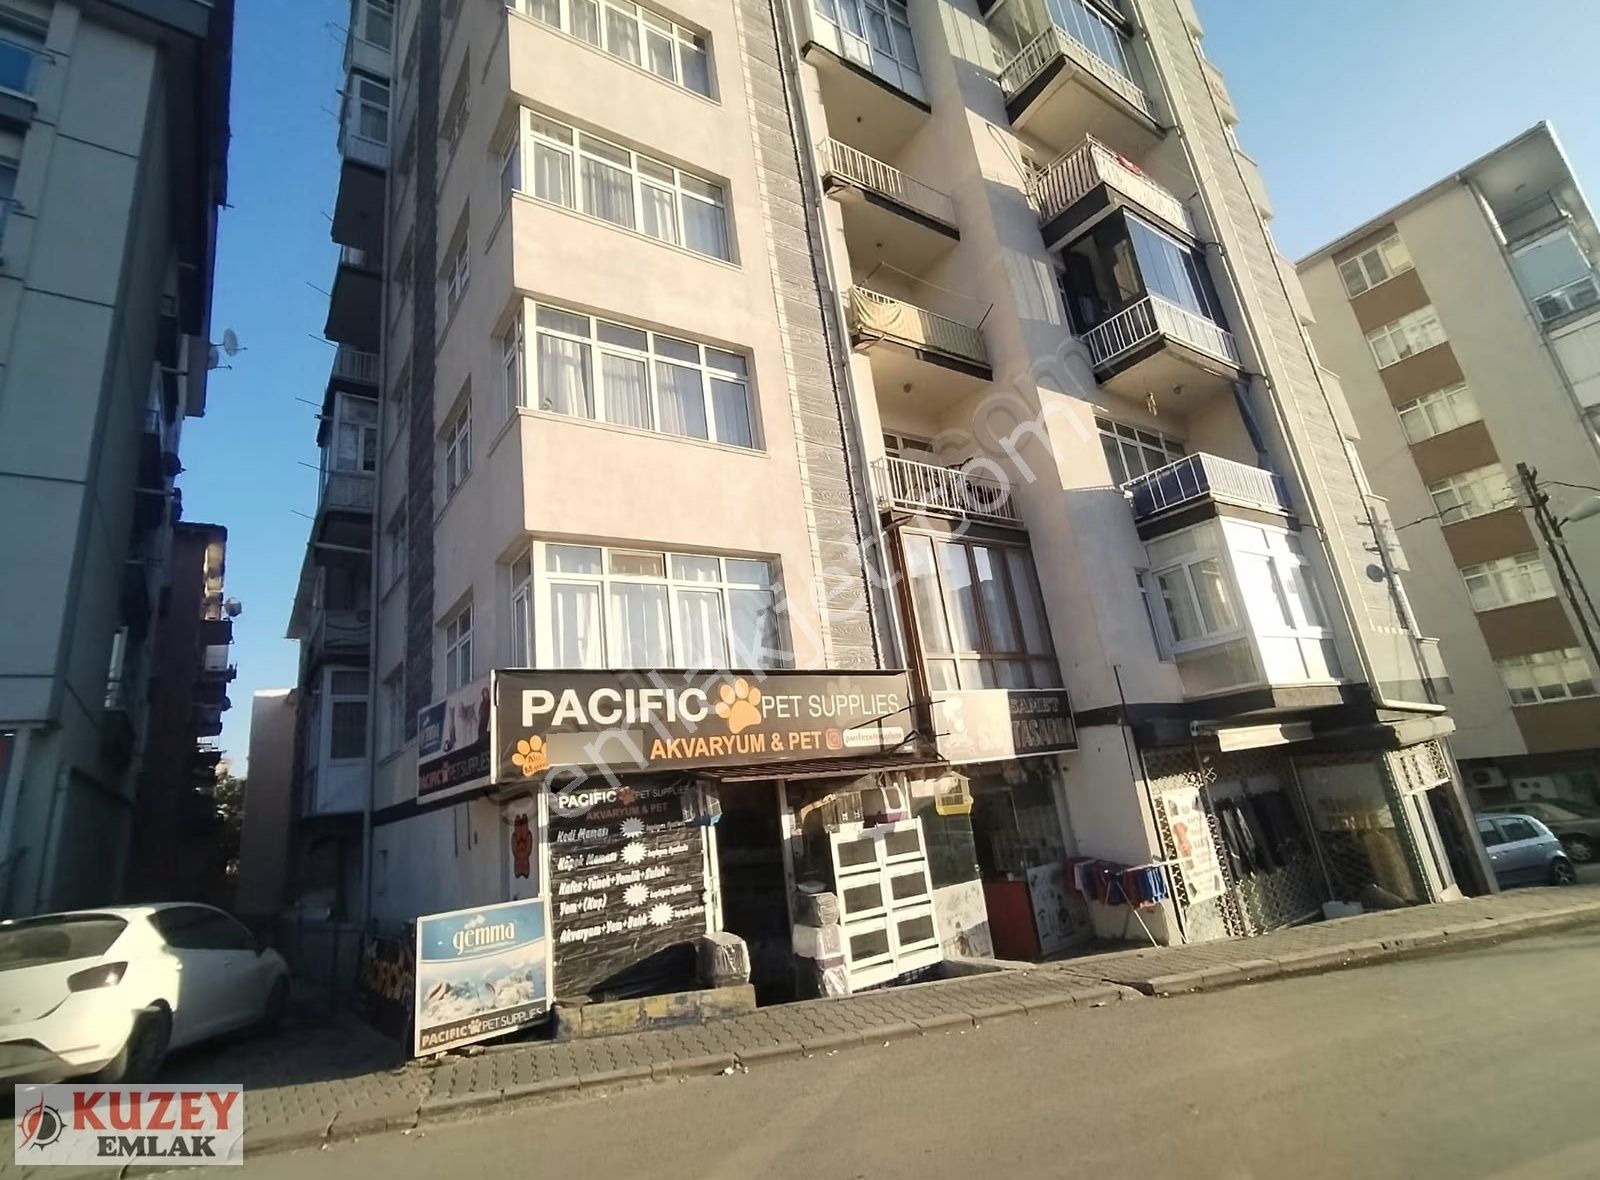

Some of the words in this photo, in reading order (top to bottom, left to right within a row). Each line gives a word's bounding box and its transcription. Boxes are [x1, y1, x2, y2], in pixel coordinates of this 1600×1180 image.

[521, 687, 708, 727] PACIFIC
[763, 697, 793, 719] PET
[807, 693, 900, 717] SUPPLIES
[650, 732, 766, 760] AKVARYUM
[771, 733, 785, 753] &
[788, 730, 822, 751] PET
[558, 791, 617, 809] PACIFIC
[635, 789, 651, 799] PET
[585, 804, 641, 821] AKVARYUM
[651, 802, 669, 813] PET
[556, 829, 577, 843] Kedi
[452, 921, 516, 956] gemma
[421, 1025, 469, 1047] PACIFIC
[482, 1018, 500, 1031] PET
